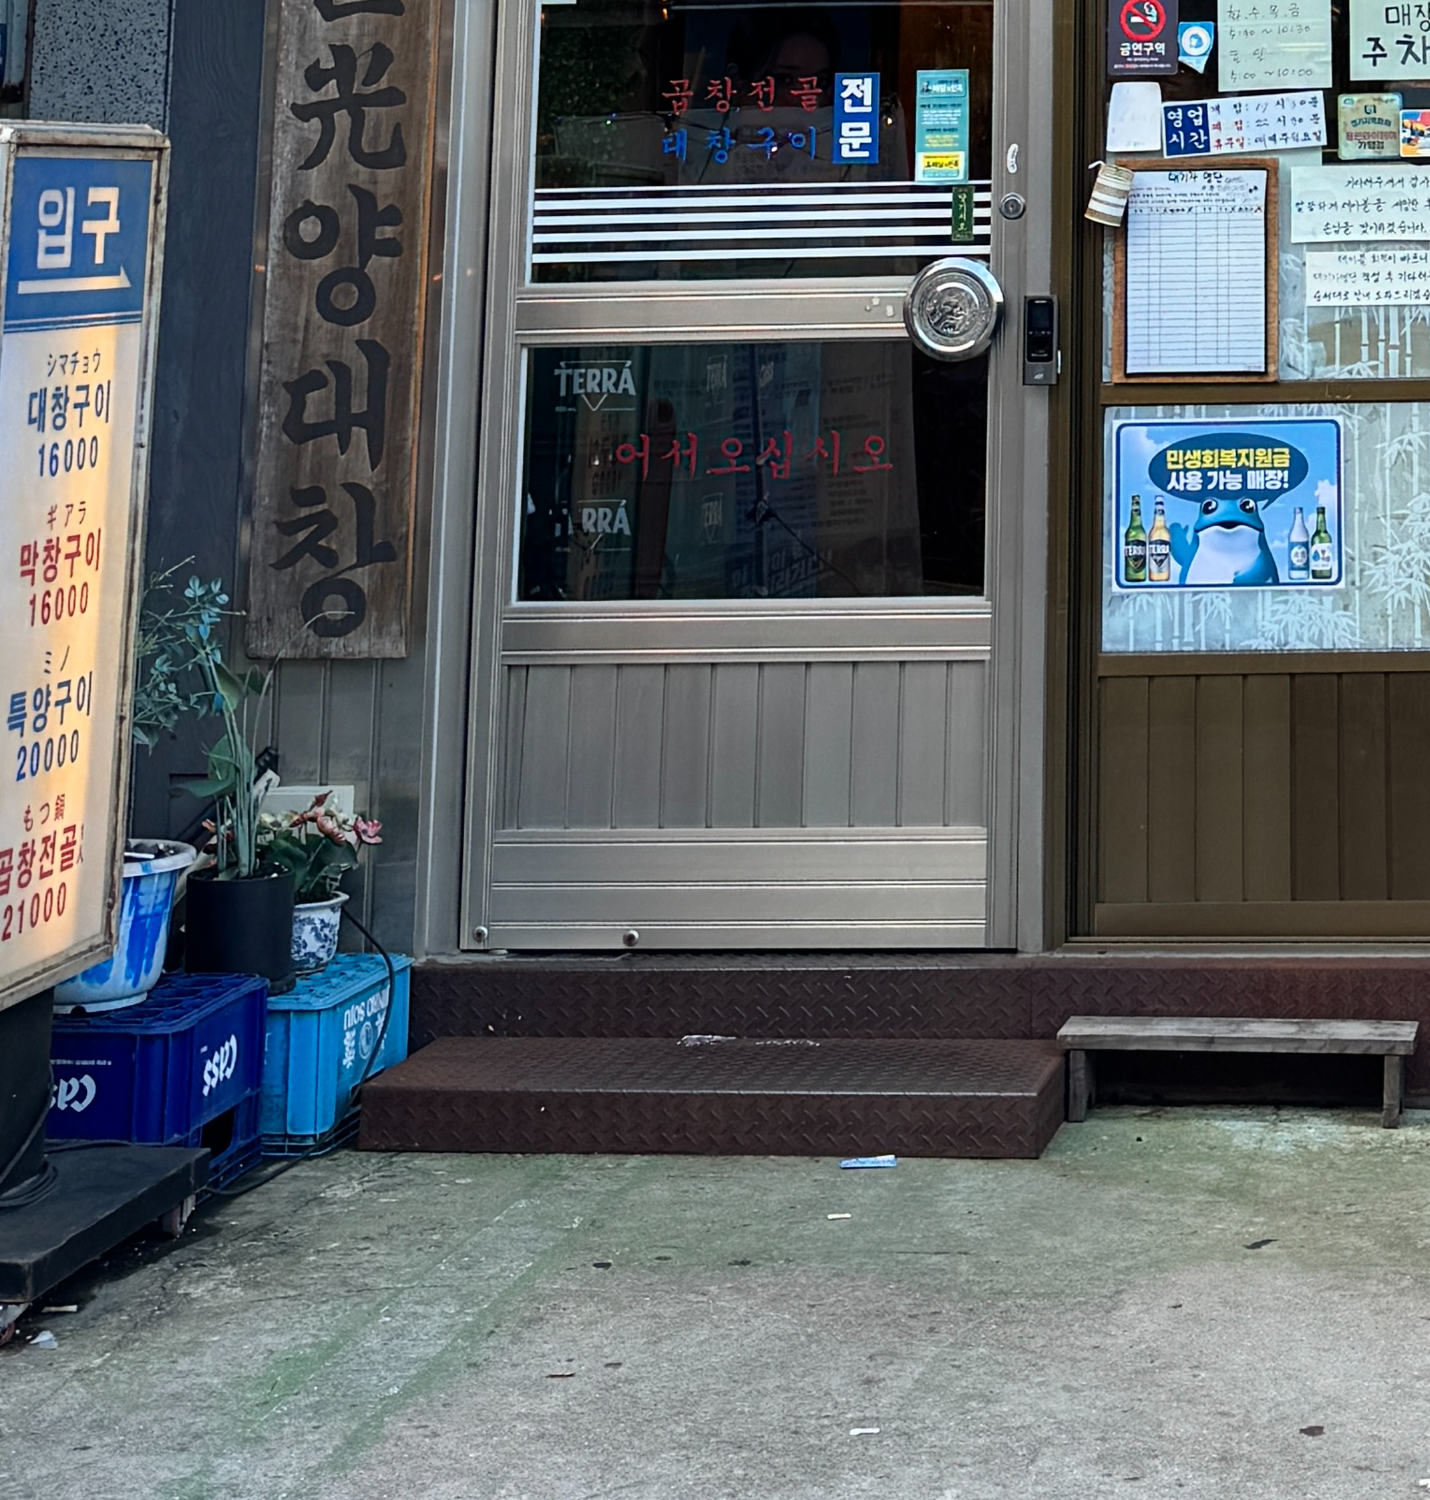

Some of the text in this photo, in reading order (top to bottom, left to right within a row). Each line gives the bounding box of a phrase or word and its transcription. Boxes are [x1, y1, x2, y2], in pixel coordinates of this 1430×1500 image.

[1119, 42, 1166, 57] 금연구역
[661, 75, 824, 114] 곱창전골
[838, 77, 873, 158] 전문
[1166, 106, 1203, 128] 영업
[661, 125, 818, 163] 대창구이
[1168, 129, 1208, 150] 시간
[1168, 171, 1223, 184] 대기자 명단
[36, 186, 121, 269] 입구
[46, 348, 102, 378] シマチョウ
[553, 365, 637, 399] TERRA
[27, 379, 111, 434] 대창구이
[38, 435, 99, 478] 16000
[615, 429, 894, 482] 어서오십시오
[1165, 447, 1291, 470] 민생회복지원금
[1166, 469, 1289, 492] 사용 가능 매장!
[46, 500, 87, 531] ギアラ
[19, 528, 102, 587] 막창구이
[29, 581, 89, 627] 16000
[43, 645, 71, 675] ミノ
[6, 671, 93, 739] 특양구이
[15, 729, 79, 782] 20000
[0, 823, 78, 896] 곱창전골
[1, 882, 67, 942] 21000
[202, 1033, 238, 1097] Cass
[50, 1074, 97, 1112] Ca
